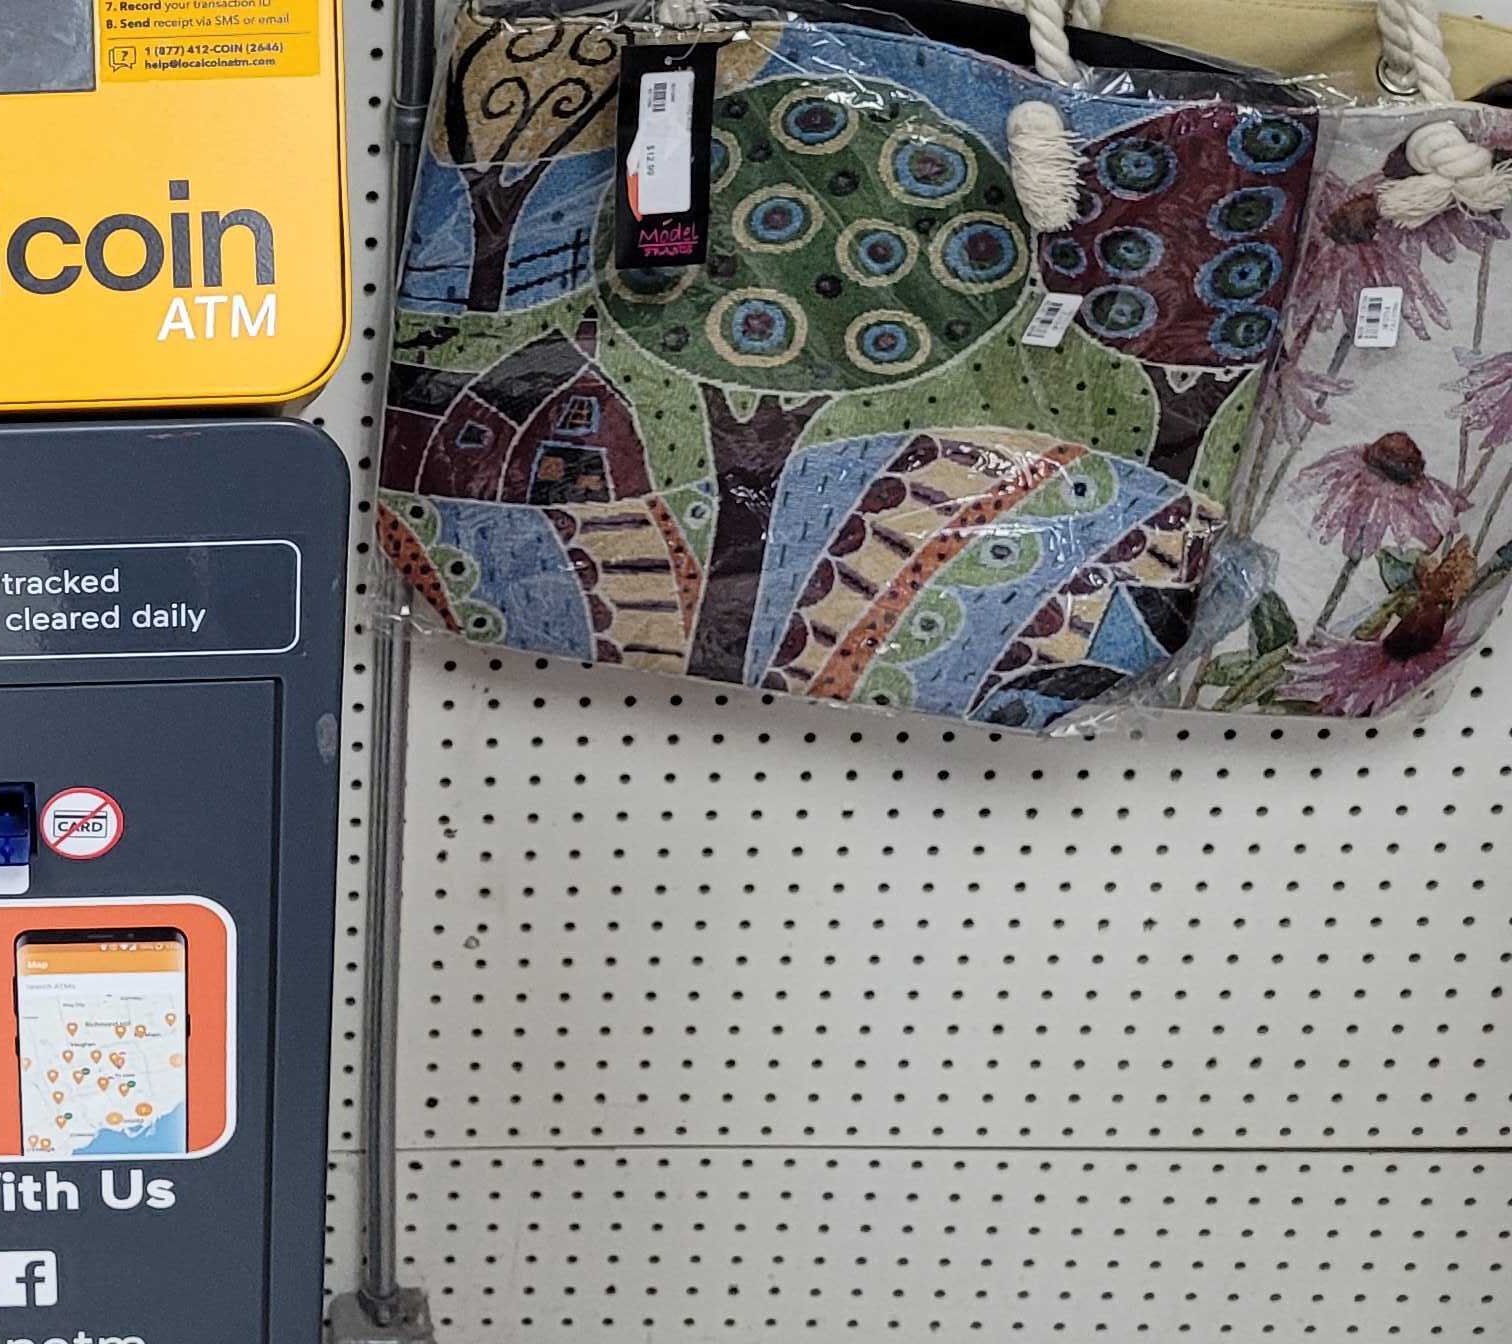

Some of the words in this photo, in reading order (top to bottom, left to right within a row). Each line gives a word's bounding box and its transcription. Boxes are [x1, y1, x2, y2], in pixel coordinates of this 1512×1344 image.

[105, 2, 117, 12] 7.
[120, 1, 162, 11] Record
[164, 0, 190, 12] your
[106, 19, 117, 29] 8.
[120, 18, 150, 28] Send
[153, 16, 193, 29] receipt
[196, 16, 212, 26] via
[215, 15, 240, 25] SMS
[243, 16, 256, 24] or
[258, 13, 289, 24] email
[145, 46, 151, 55] 1
[154, 45, 184, 56] (877)
[187, 44, 243, 54] 412-COIN
[246, 42, 283, 54] (2646)
[144, 57, 275, 71] help@localcoinatm.com
[155, 294, 278, 341] ATM
[1, 567, 121, 595] tracked
[4, 603, 121, 630] cleared
[130, 602, 207, 633] daily
[57, 820, 103, 833] CARD
[100, 1168, 177, 1209] Us
